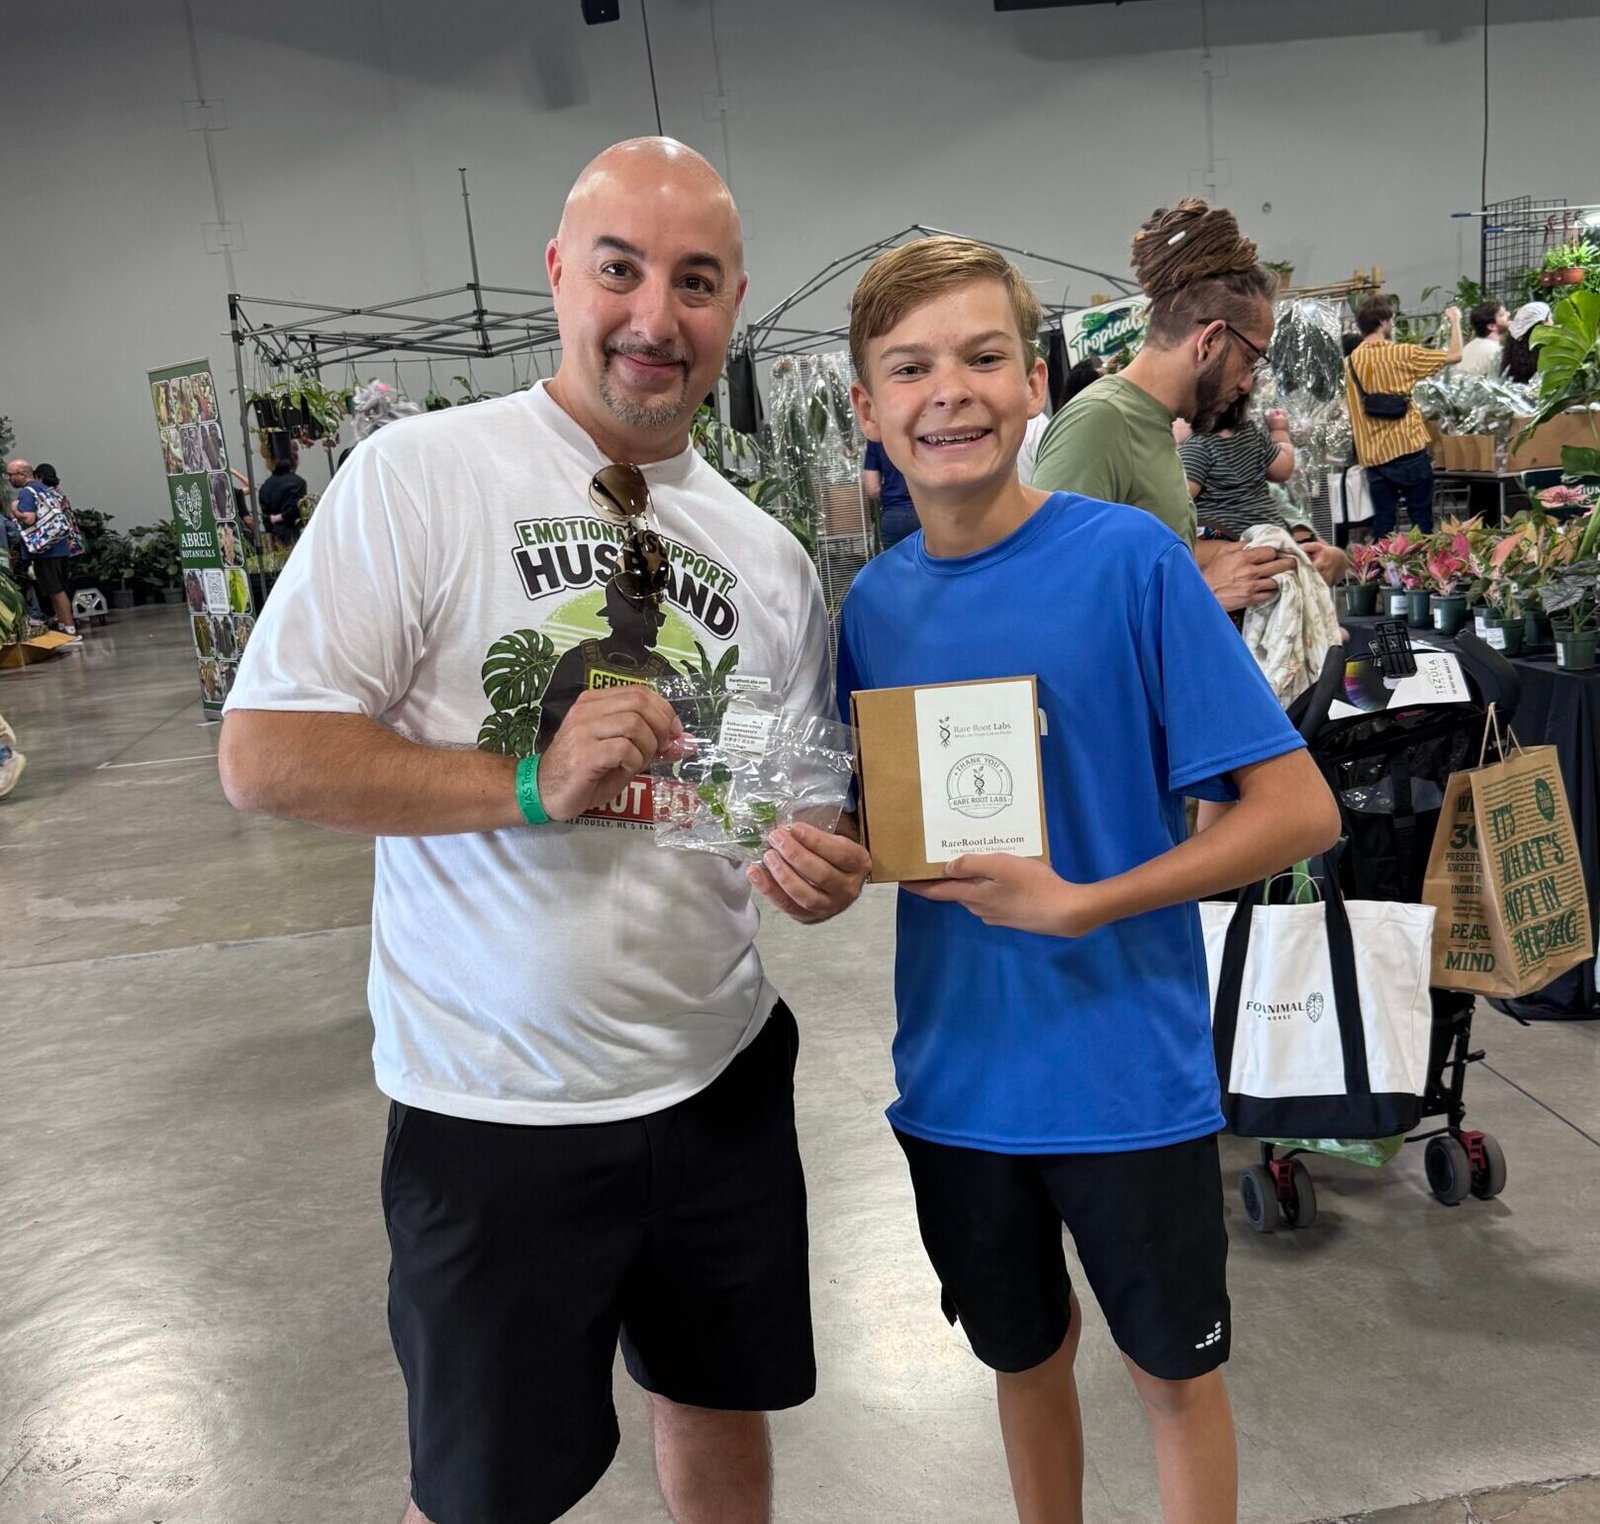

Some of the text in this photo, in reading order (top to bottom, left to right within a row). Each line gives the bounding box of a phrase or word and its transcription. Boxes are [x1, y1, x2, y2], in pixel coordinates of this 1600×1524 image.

[181, 531, 213, 548] ABREU
[519, 518, 634, 547] EMOTIONA
[182, 549, 216, 559] BOTANICALS
[516, 543, 736, 636] HUSAND
[954, 721, 1011, 733] Rare Root Labs
[956, 756, 1001, 772] THANK YOU
[971, 796, 989, 804] ROOT
[990, 795, 1007, 803] LABS
[941, 836, 1025, 848] RareRootLabs.com
[1499, 832, 1565, 885] WHAT'S
[1504, 884, 1540, 927] NOT
[1539, 876, 1563, 911] IN
[1444, 951, 1496, 973] MIND
